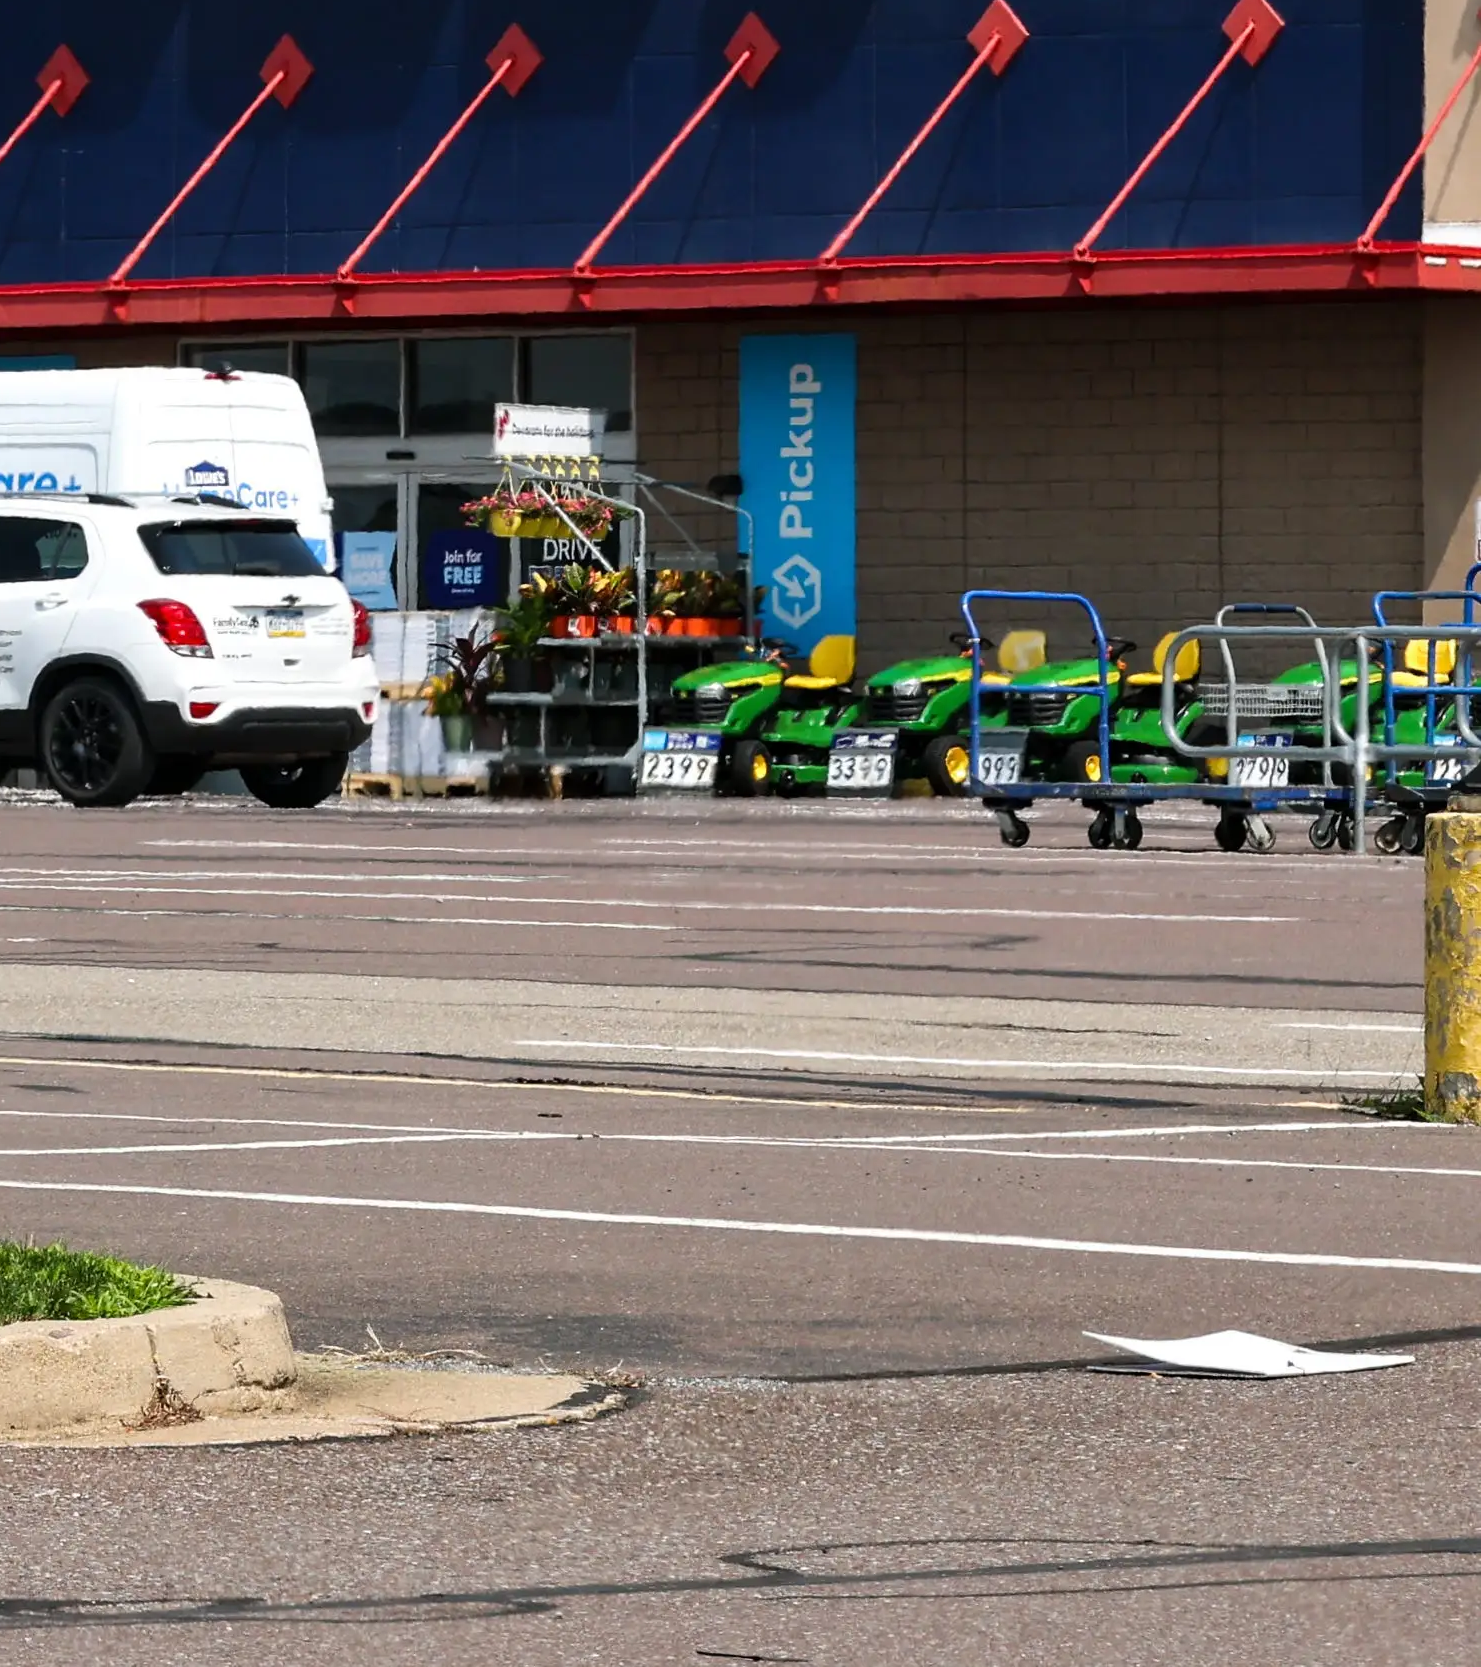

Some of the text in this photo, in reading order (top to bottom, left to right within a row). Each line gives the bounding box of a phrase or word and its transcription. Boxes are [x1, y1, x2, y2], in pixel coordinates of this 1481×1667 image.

[779, 362, 822, 539] Pickup
[189, 468, 226, 485] LOWE'S
[443, 548, 483, 564] Join for
[542, 538, 604, 562] DRIVE
[443, 565, 484, 585] FREE
[647, 754, 709, 781] 2399
[830, 755, 887, 781] 3399
